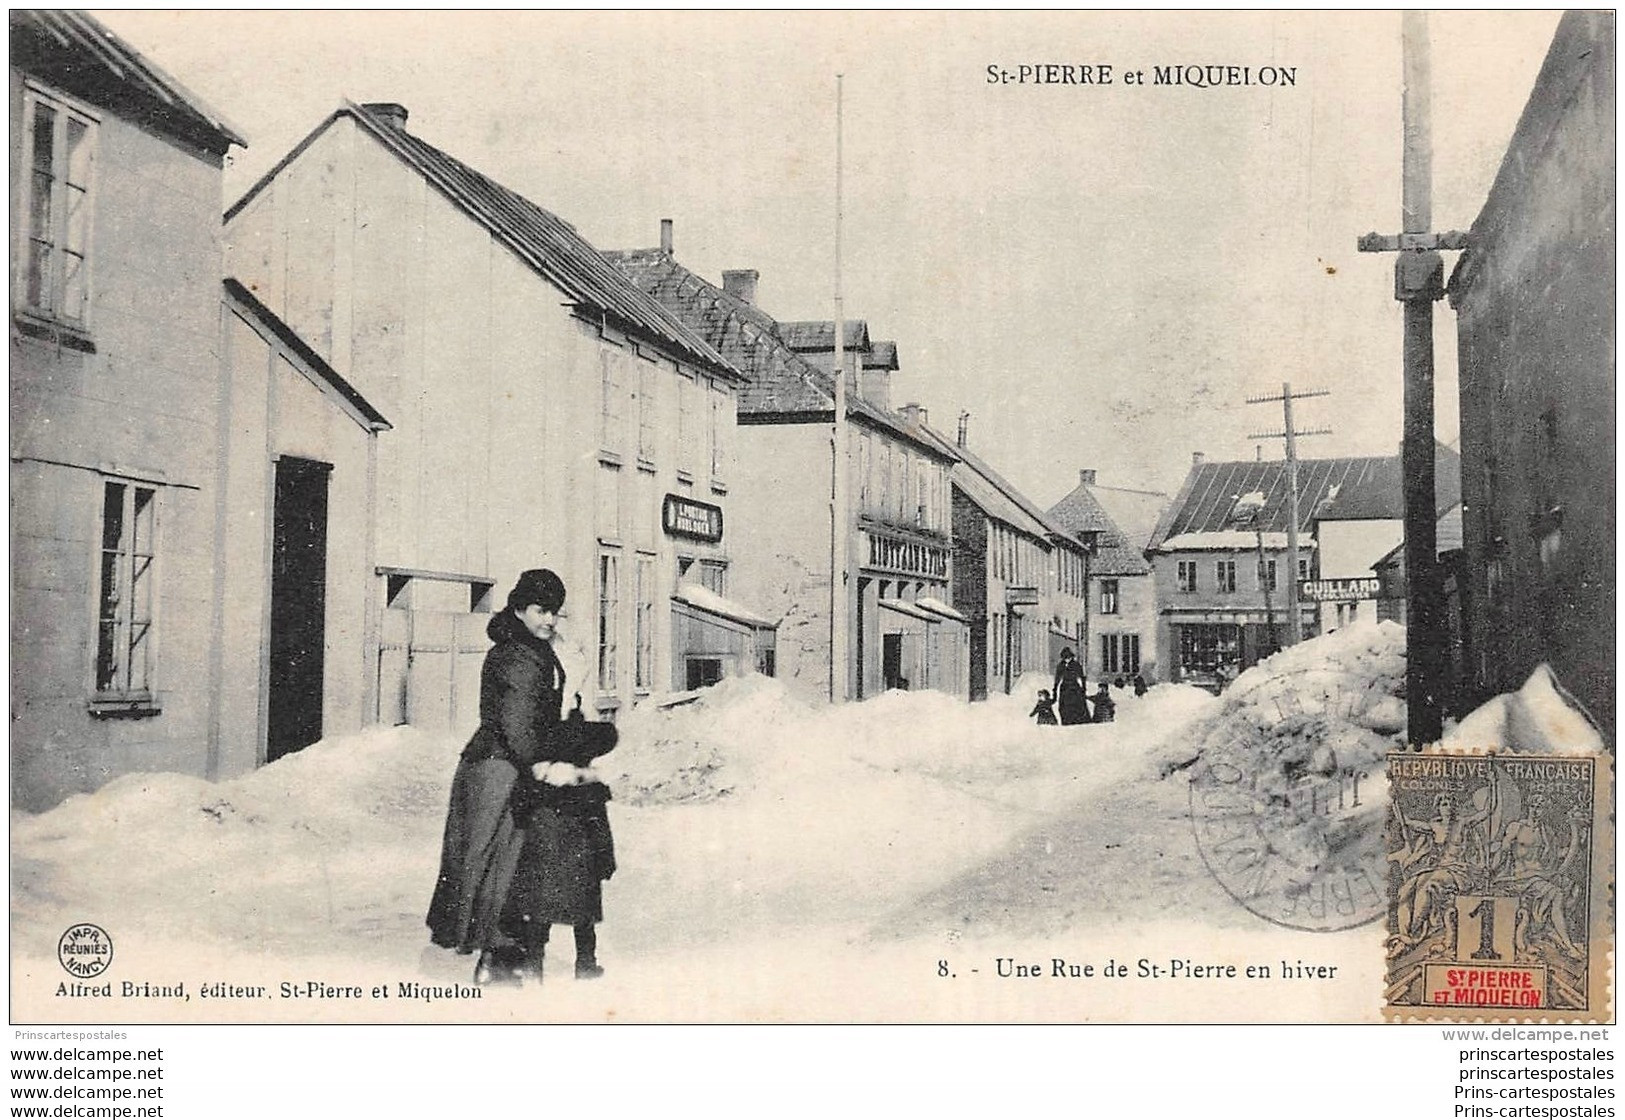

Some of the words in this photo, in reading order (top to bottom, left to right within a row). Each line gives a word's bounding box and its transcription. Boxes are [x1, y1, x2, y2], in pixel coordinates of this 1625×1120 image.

[1468, 899, 1502, 960] 1
[1468, 970, 1533, 988] PIERRE
[1434, 991, 1450, 1004] ET
[1455, 988, 1541, 1007] MIQUELON
